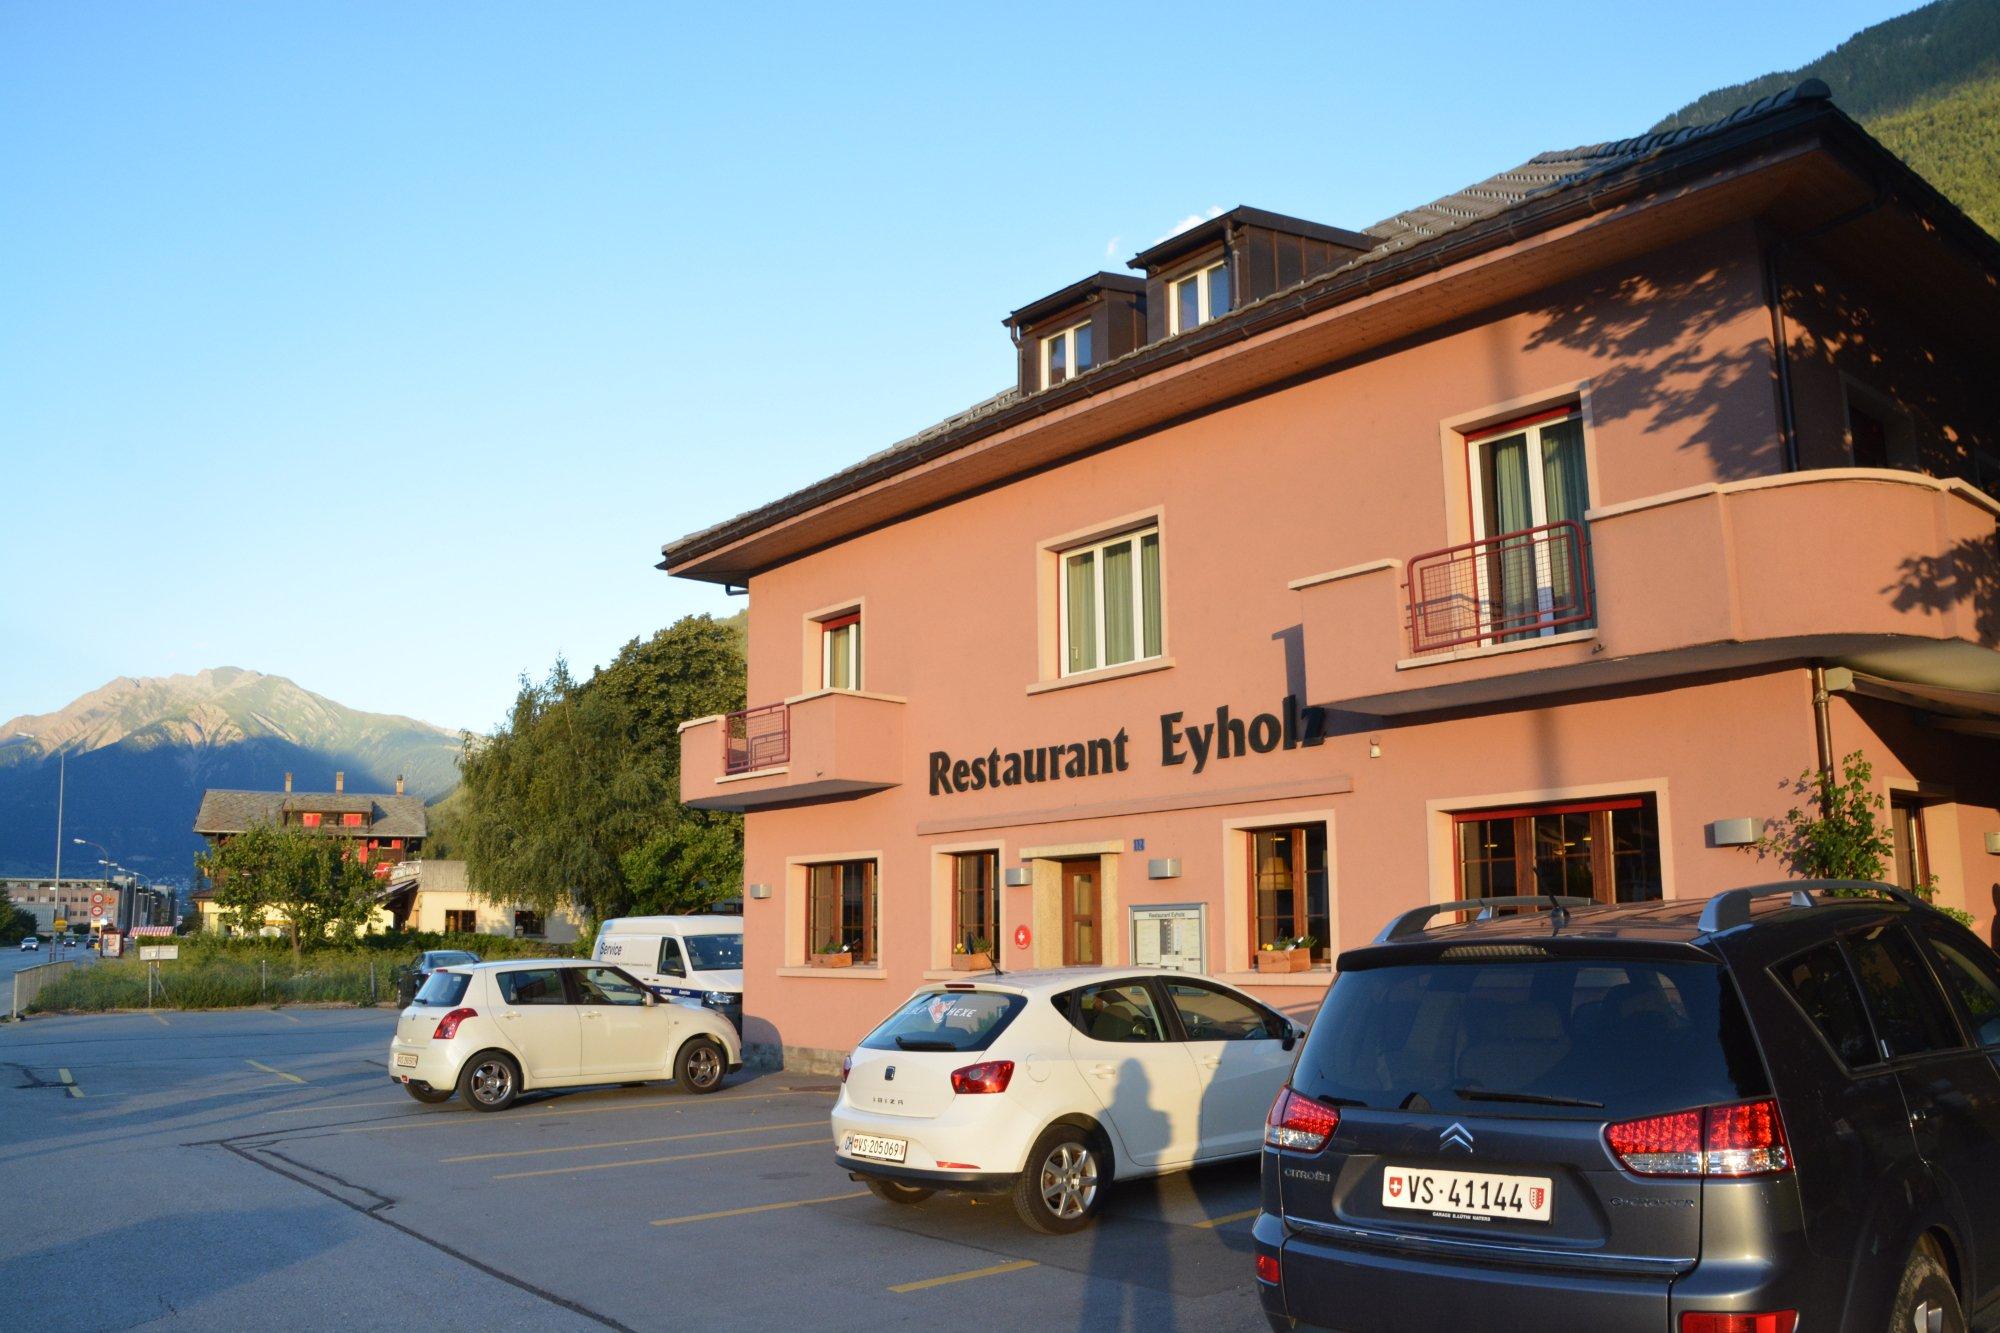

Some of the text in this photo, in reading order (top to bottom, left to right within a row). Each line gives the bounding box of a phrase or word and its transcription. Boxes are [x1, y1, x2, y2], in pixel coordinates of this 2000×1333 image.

[929, 694, 1328, 796] Restaurant Eyholz
[600, 942, 622, 956] Service
[946, 1007, 977, 1018] HEXE
[872, 1097, 904, 1105] IBIZA
